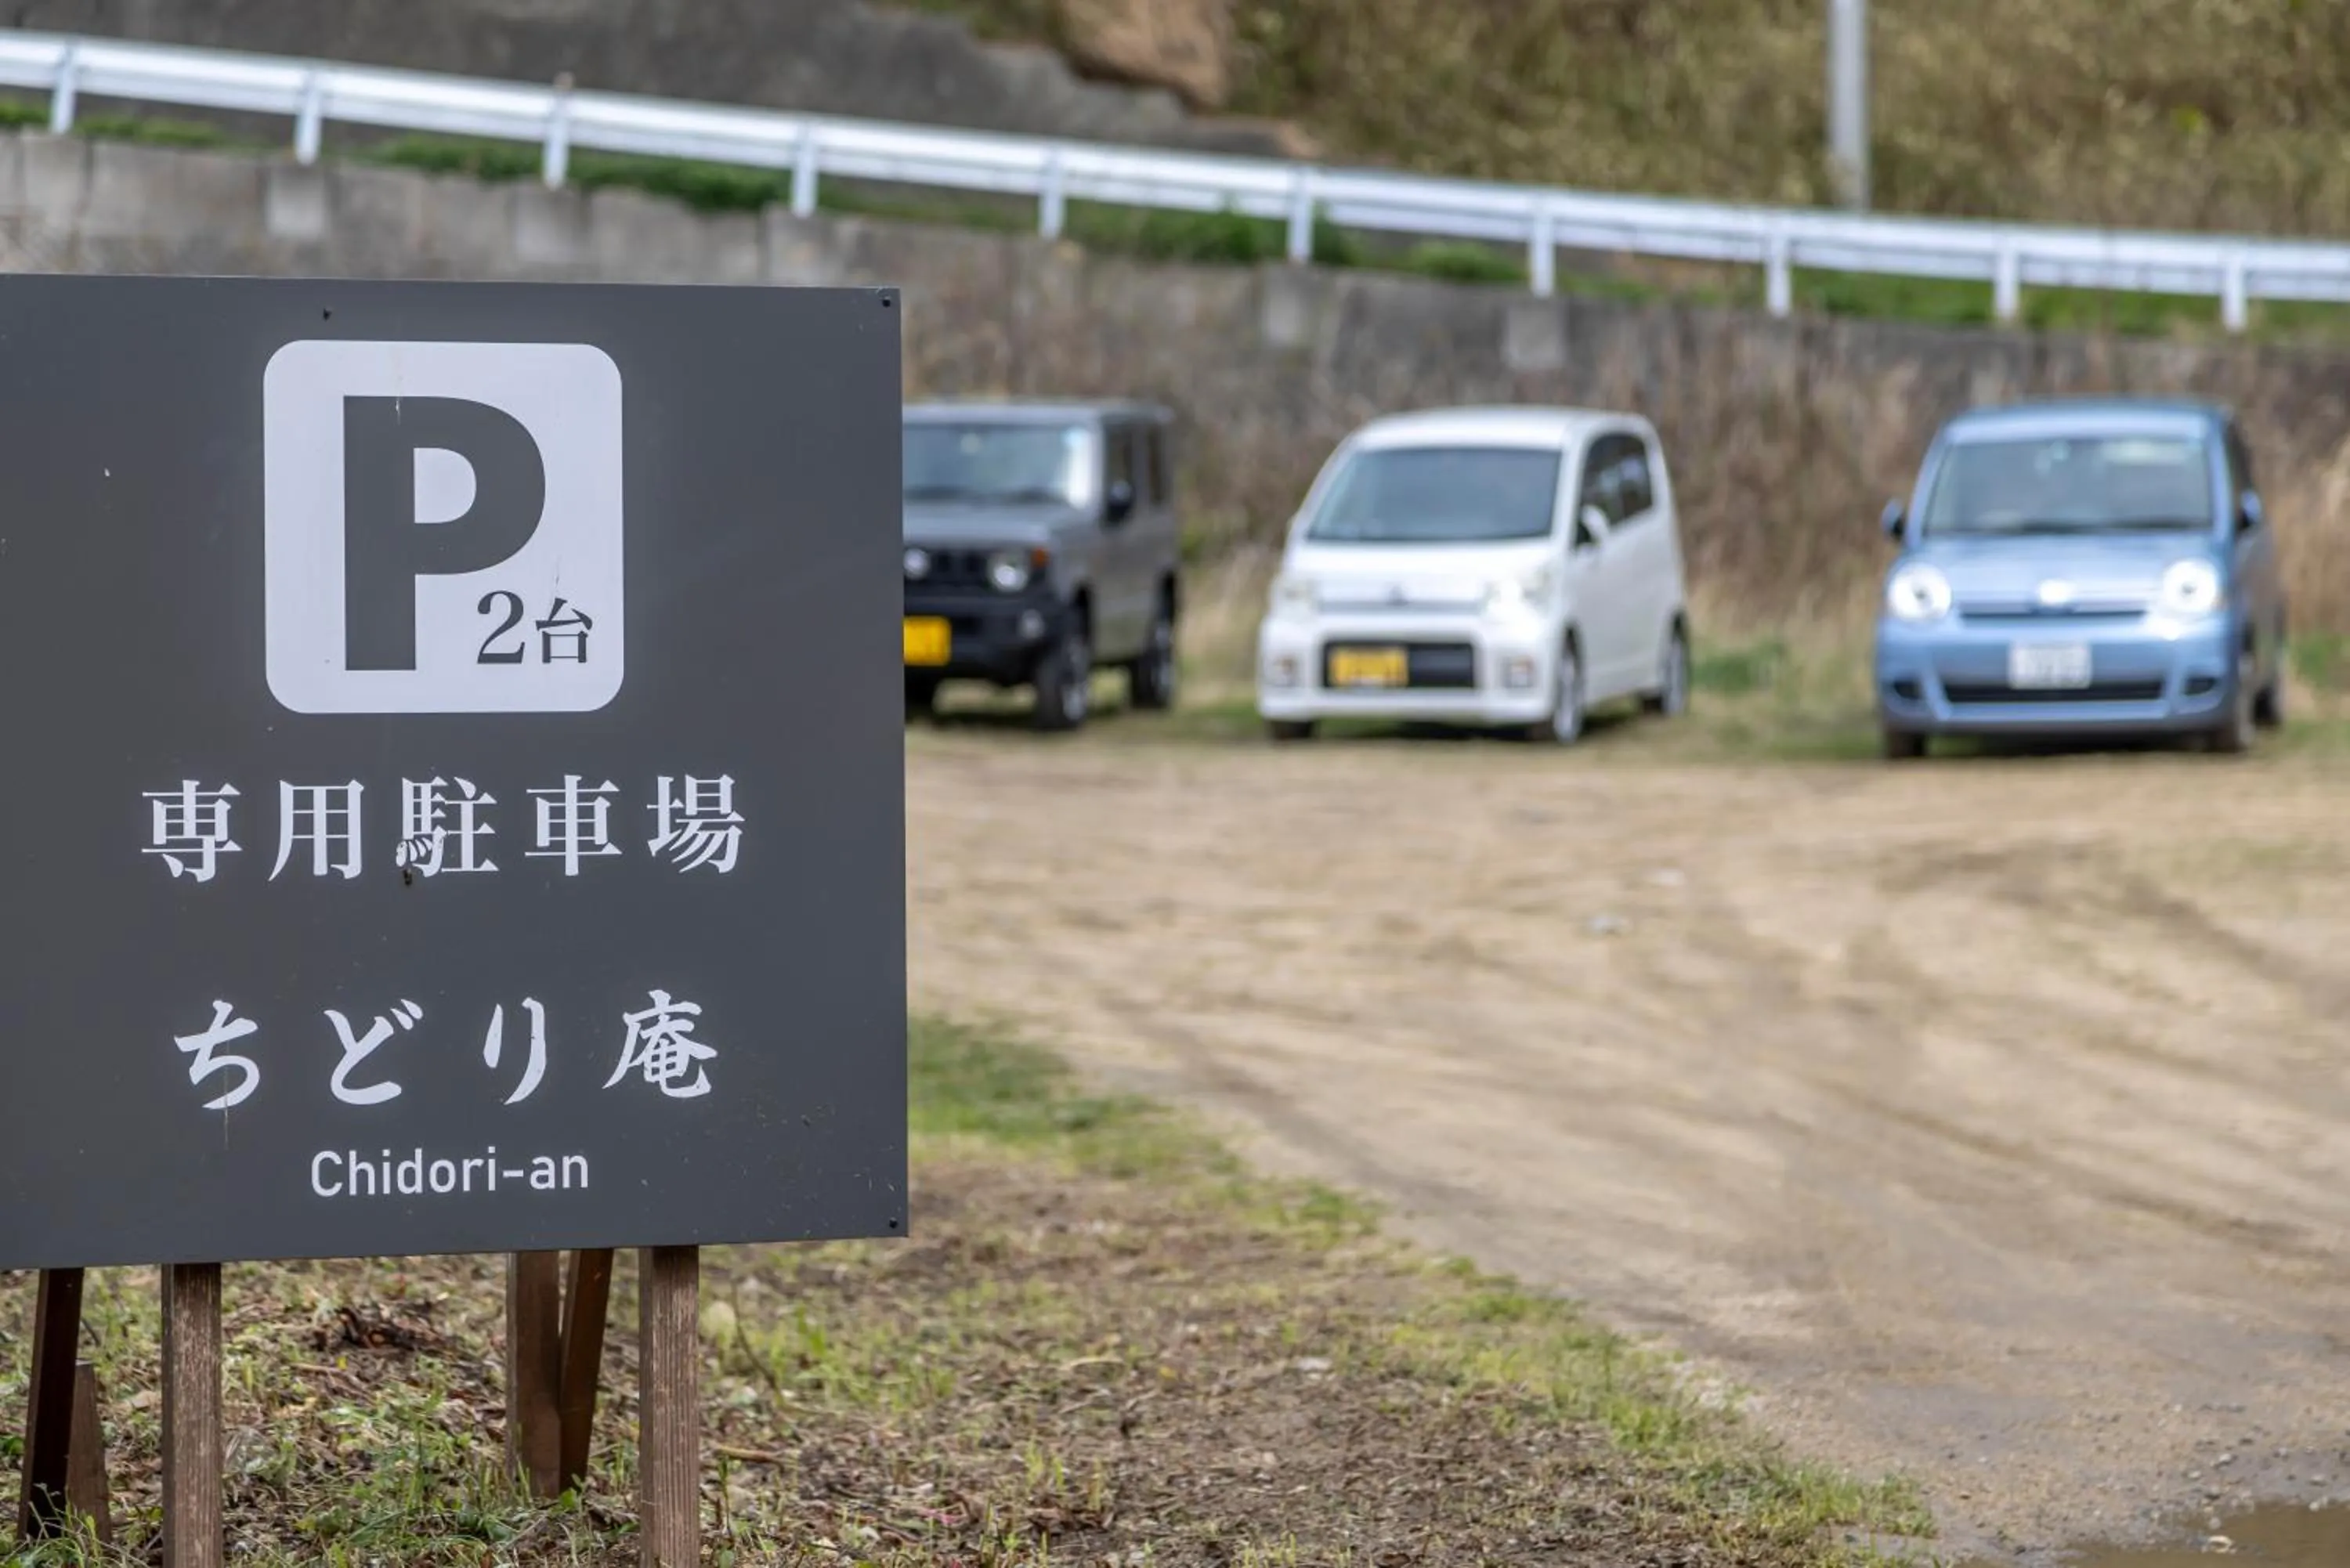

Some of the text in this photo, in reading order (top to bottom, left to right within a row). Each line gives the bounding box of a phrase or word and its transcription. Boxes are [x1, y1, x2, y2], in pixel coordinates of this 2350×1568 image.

[343, 396, 546, 671] P
[477, 590, 593, 665] 2台
[141, 774, 745, 883] 専用駐車場
[174, 989, 718, 1110] ちどり庵
[311, 1146, 589, 1197] Chidori-an
